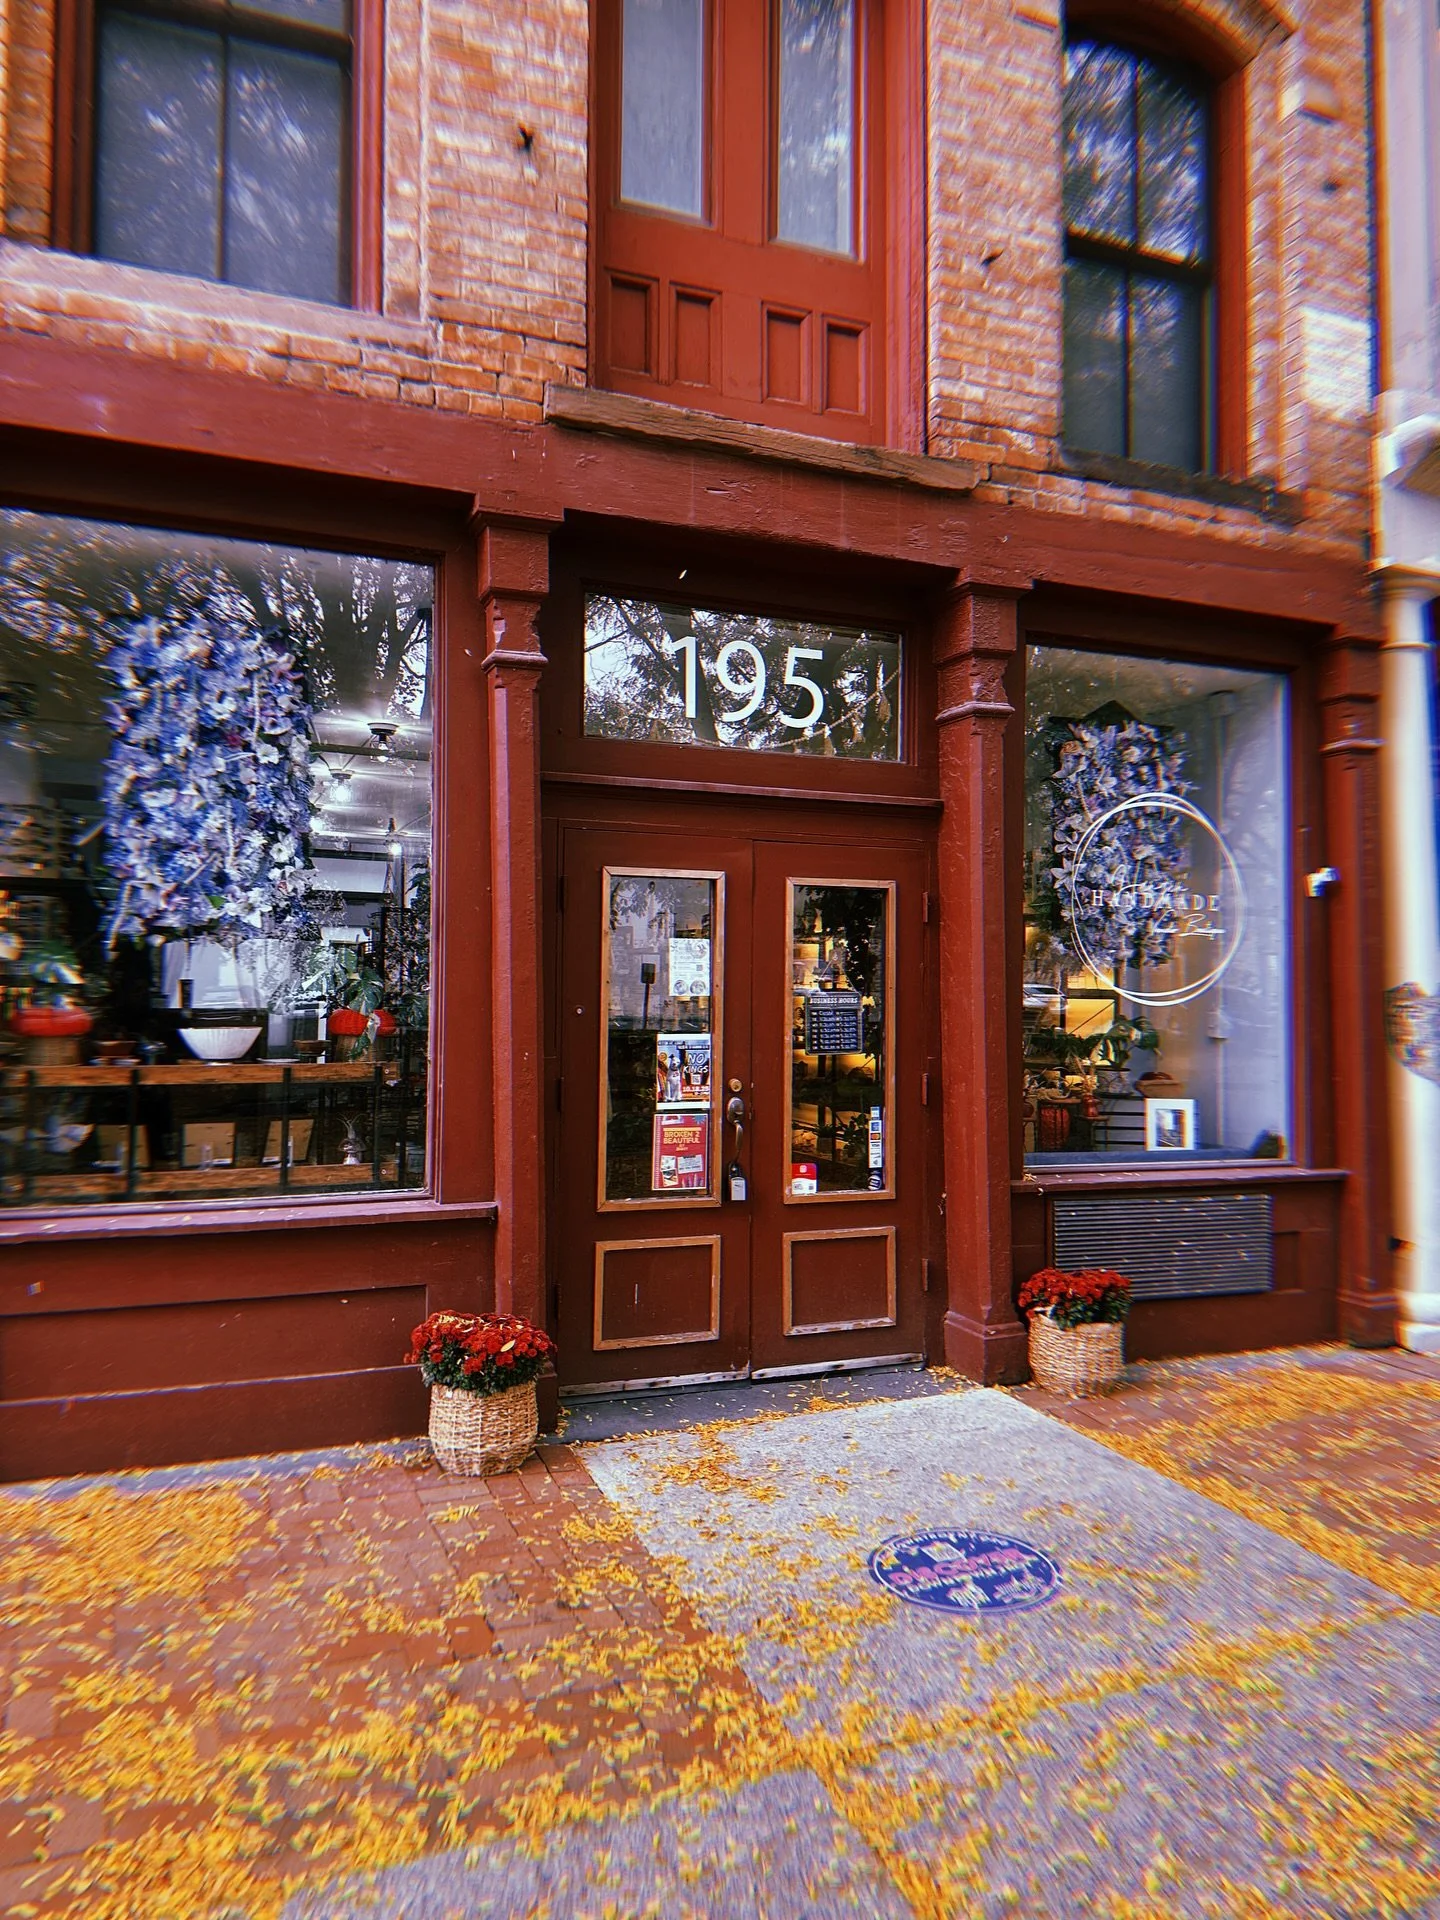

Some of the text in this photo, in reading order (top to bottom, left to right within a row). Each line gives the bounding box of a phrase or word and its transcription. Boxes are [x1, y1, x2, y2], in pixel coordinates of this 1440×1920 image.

[671, 635, 824, 729] 195
[687, 1053, 705, 1065] NO
[684, 1065, 709, 1074] KINGS
